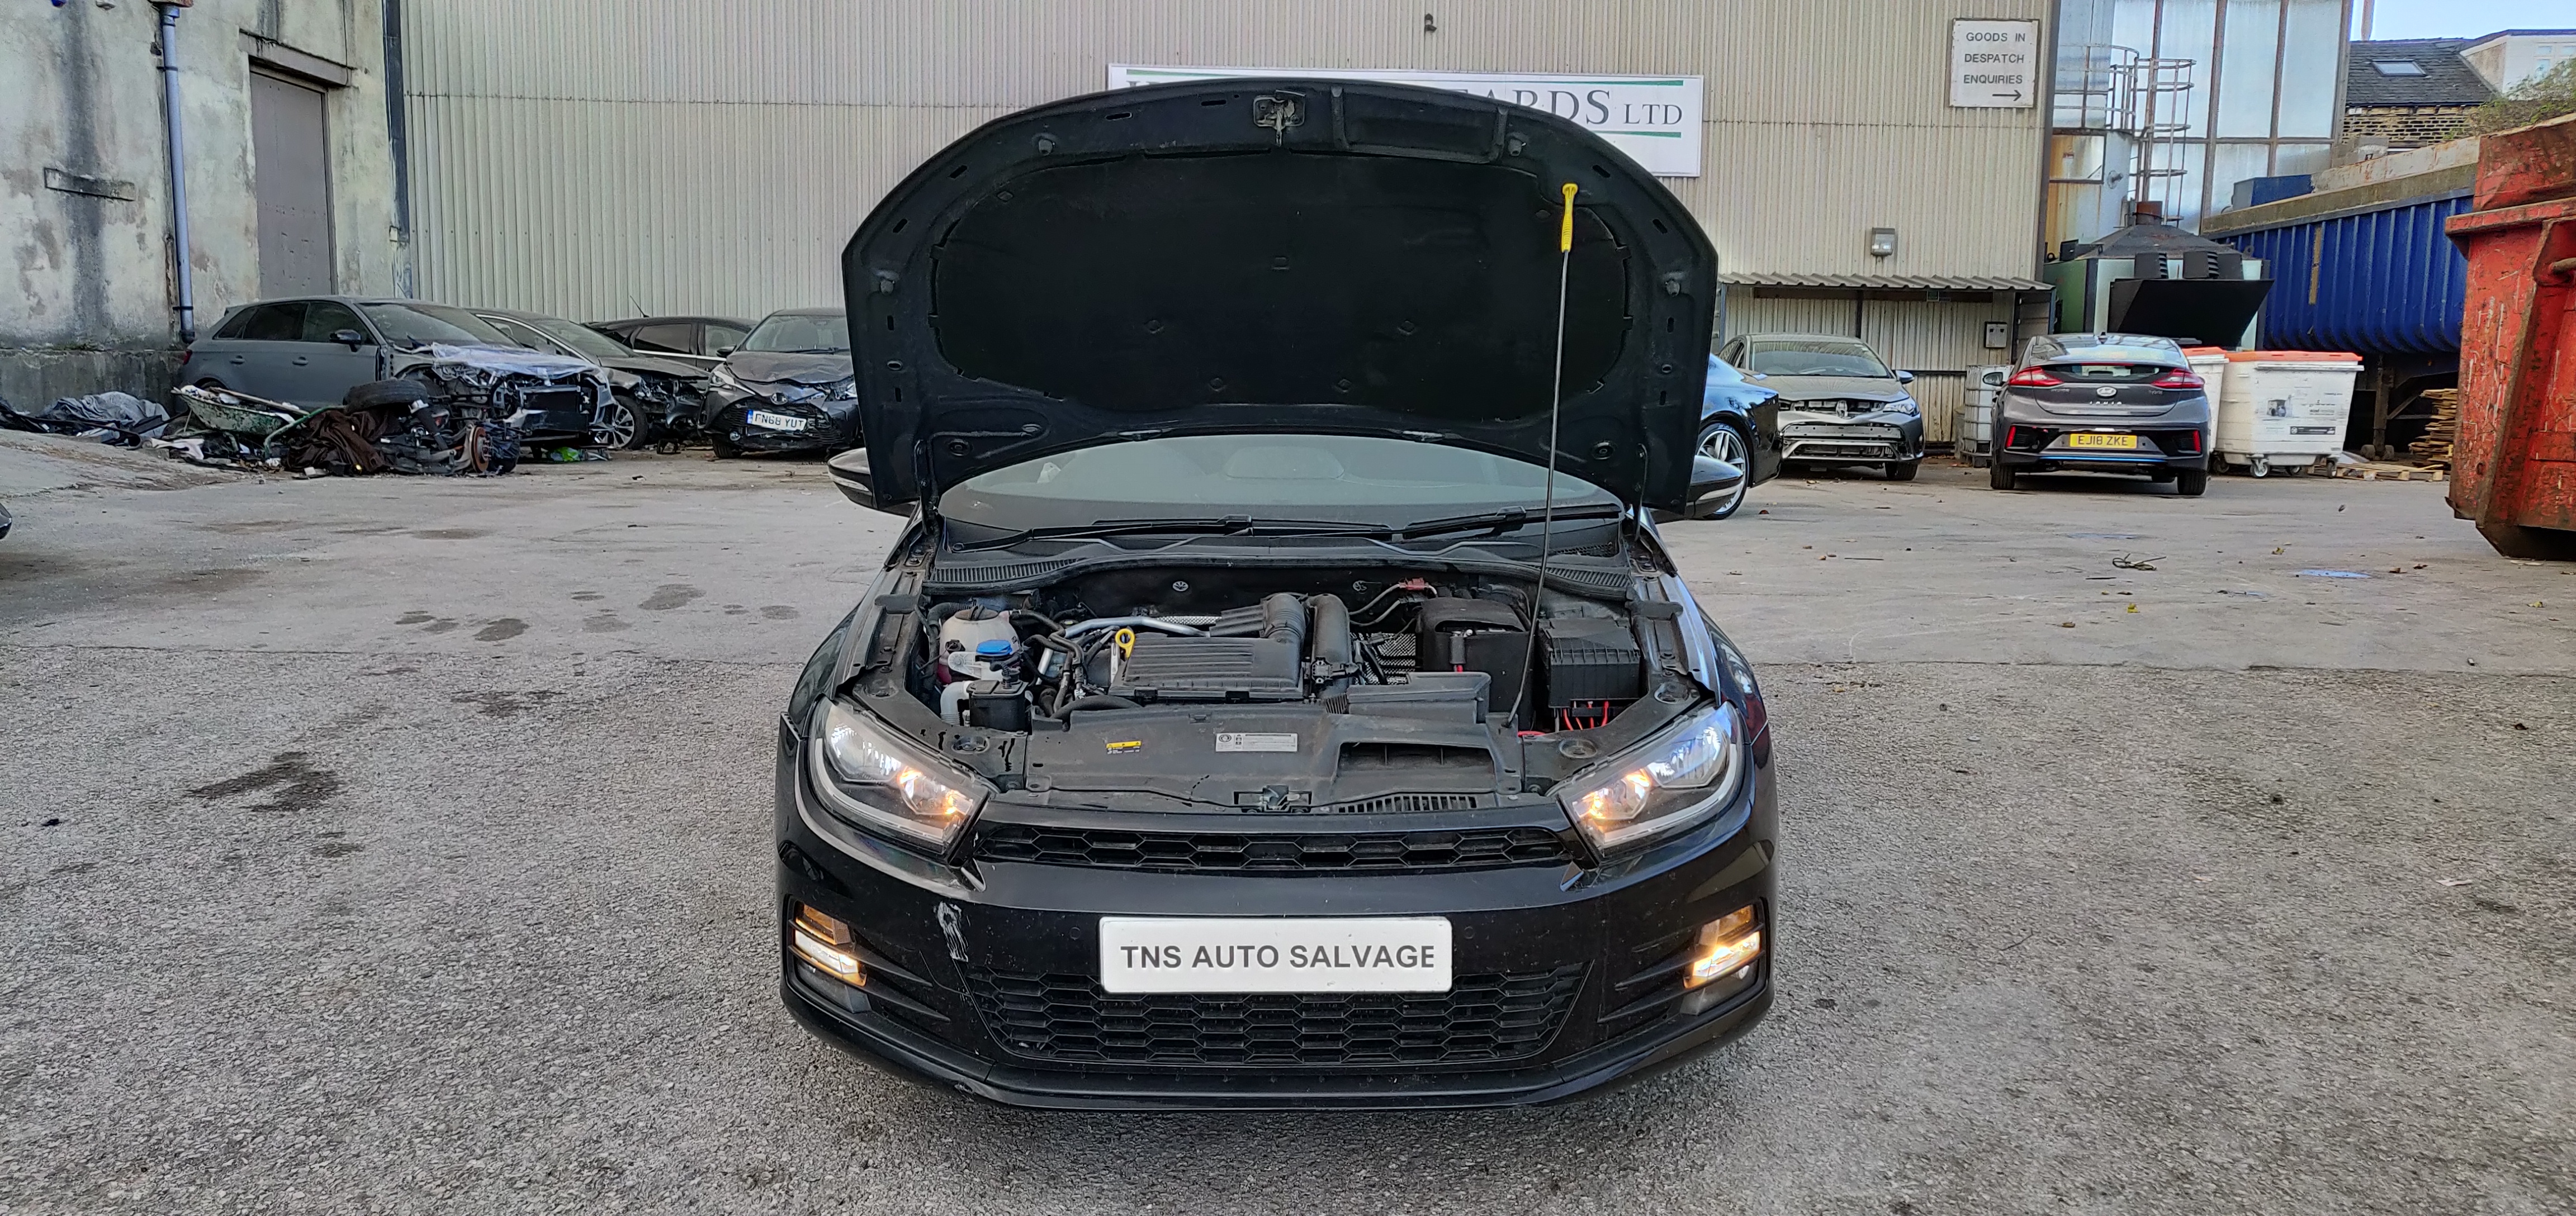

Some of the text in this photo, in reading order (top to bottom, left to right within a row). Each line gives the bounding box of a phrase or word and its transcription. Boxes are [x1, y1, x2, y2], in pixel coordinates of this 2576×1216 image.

[1966, 32, 2025, 42] GOODS IN
[1964, 54, 2024, 63] DESPATCH
[1963, 74, 2023, 84] ENQUIRIES
[1623, 103, 1682, 125] LTD
[755, 414, 804, 428] FN68 YUT
[2077, 435, 2128, 445] EJ18 ZKE
[1120, 945, 1434, 968] TNS AUTO SALVAGE
